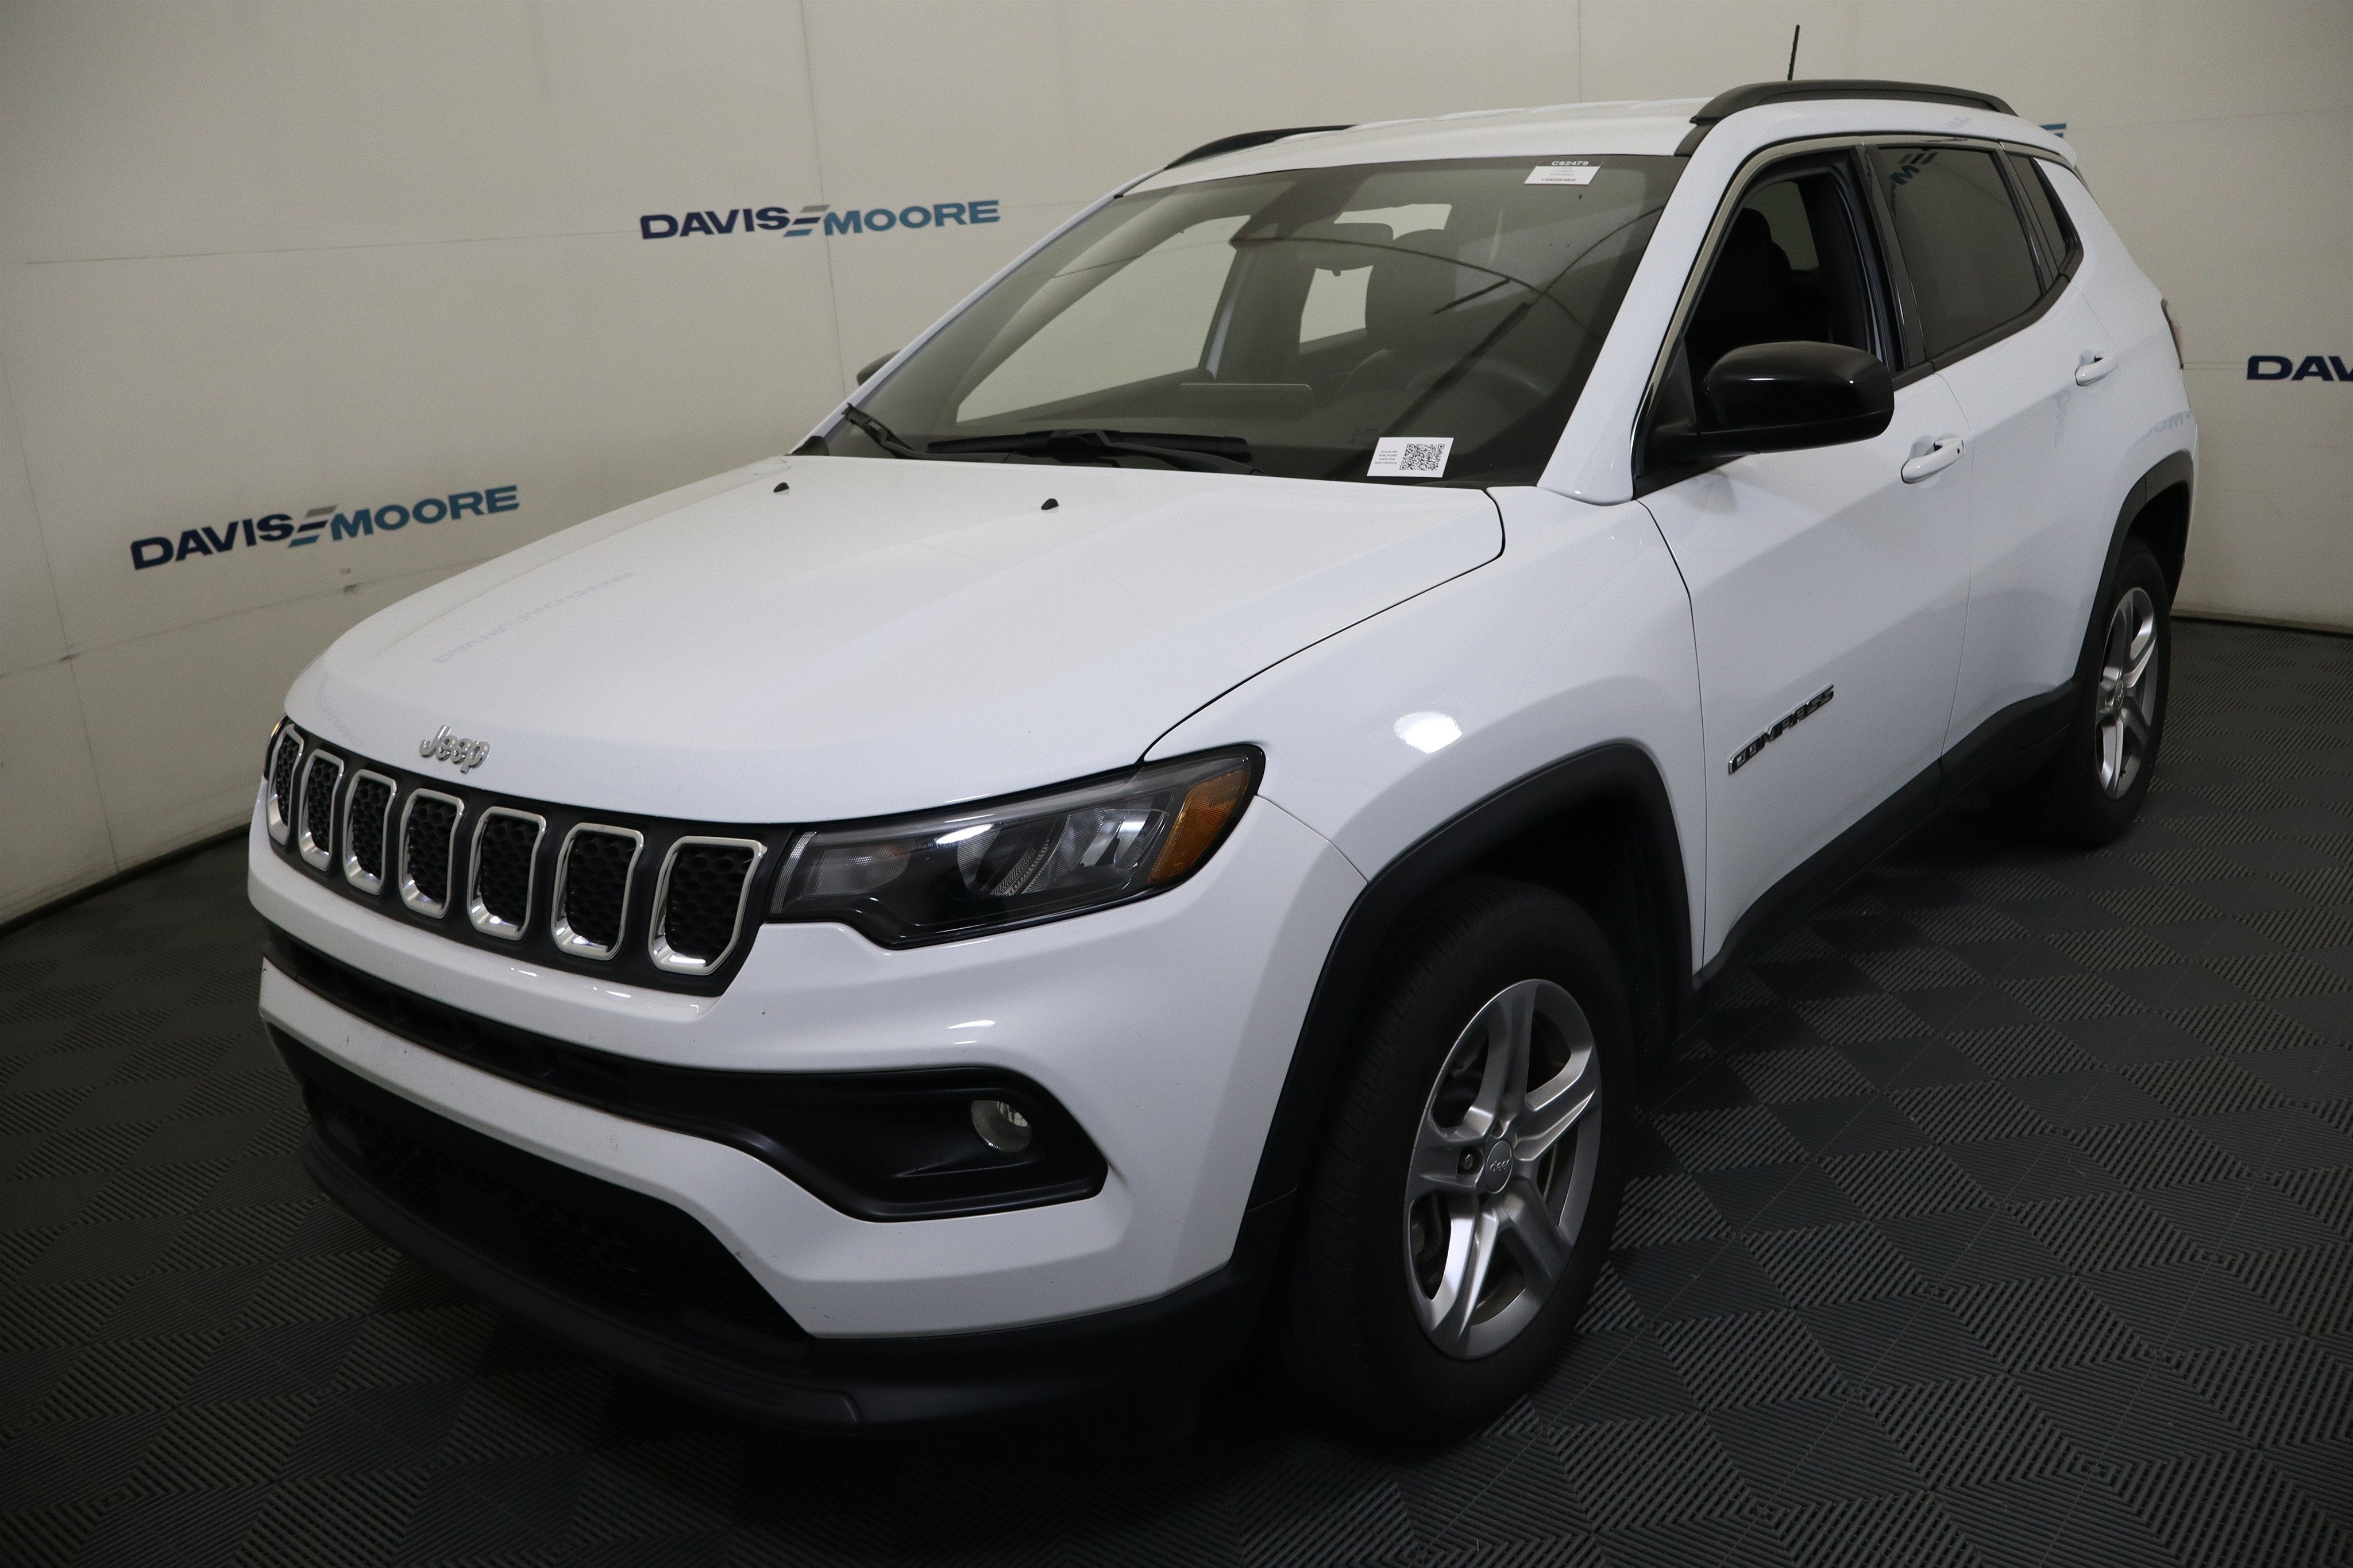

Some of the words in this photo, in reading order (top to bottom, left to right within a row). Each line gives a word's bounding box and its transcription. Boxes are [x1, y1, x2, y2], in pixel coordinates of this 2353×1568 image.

[640, 206, 790, 239] DAVIS
[823, 199, 1001, 236] MOORE
[130, 513, 294, 570] DAVIS
[329, 484, 519, 541] MOORE
[419, 725, 489, 774] Jeep
[1728, 682, 1834, 775] COMPASS
